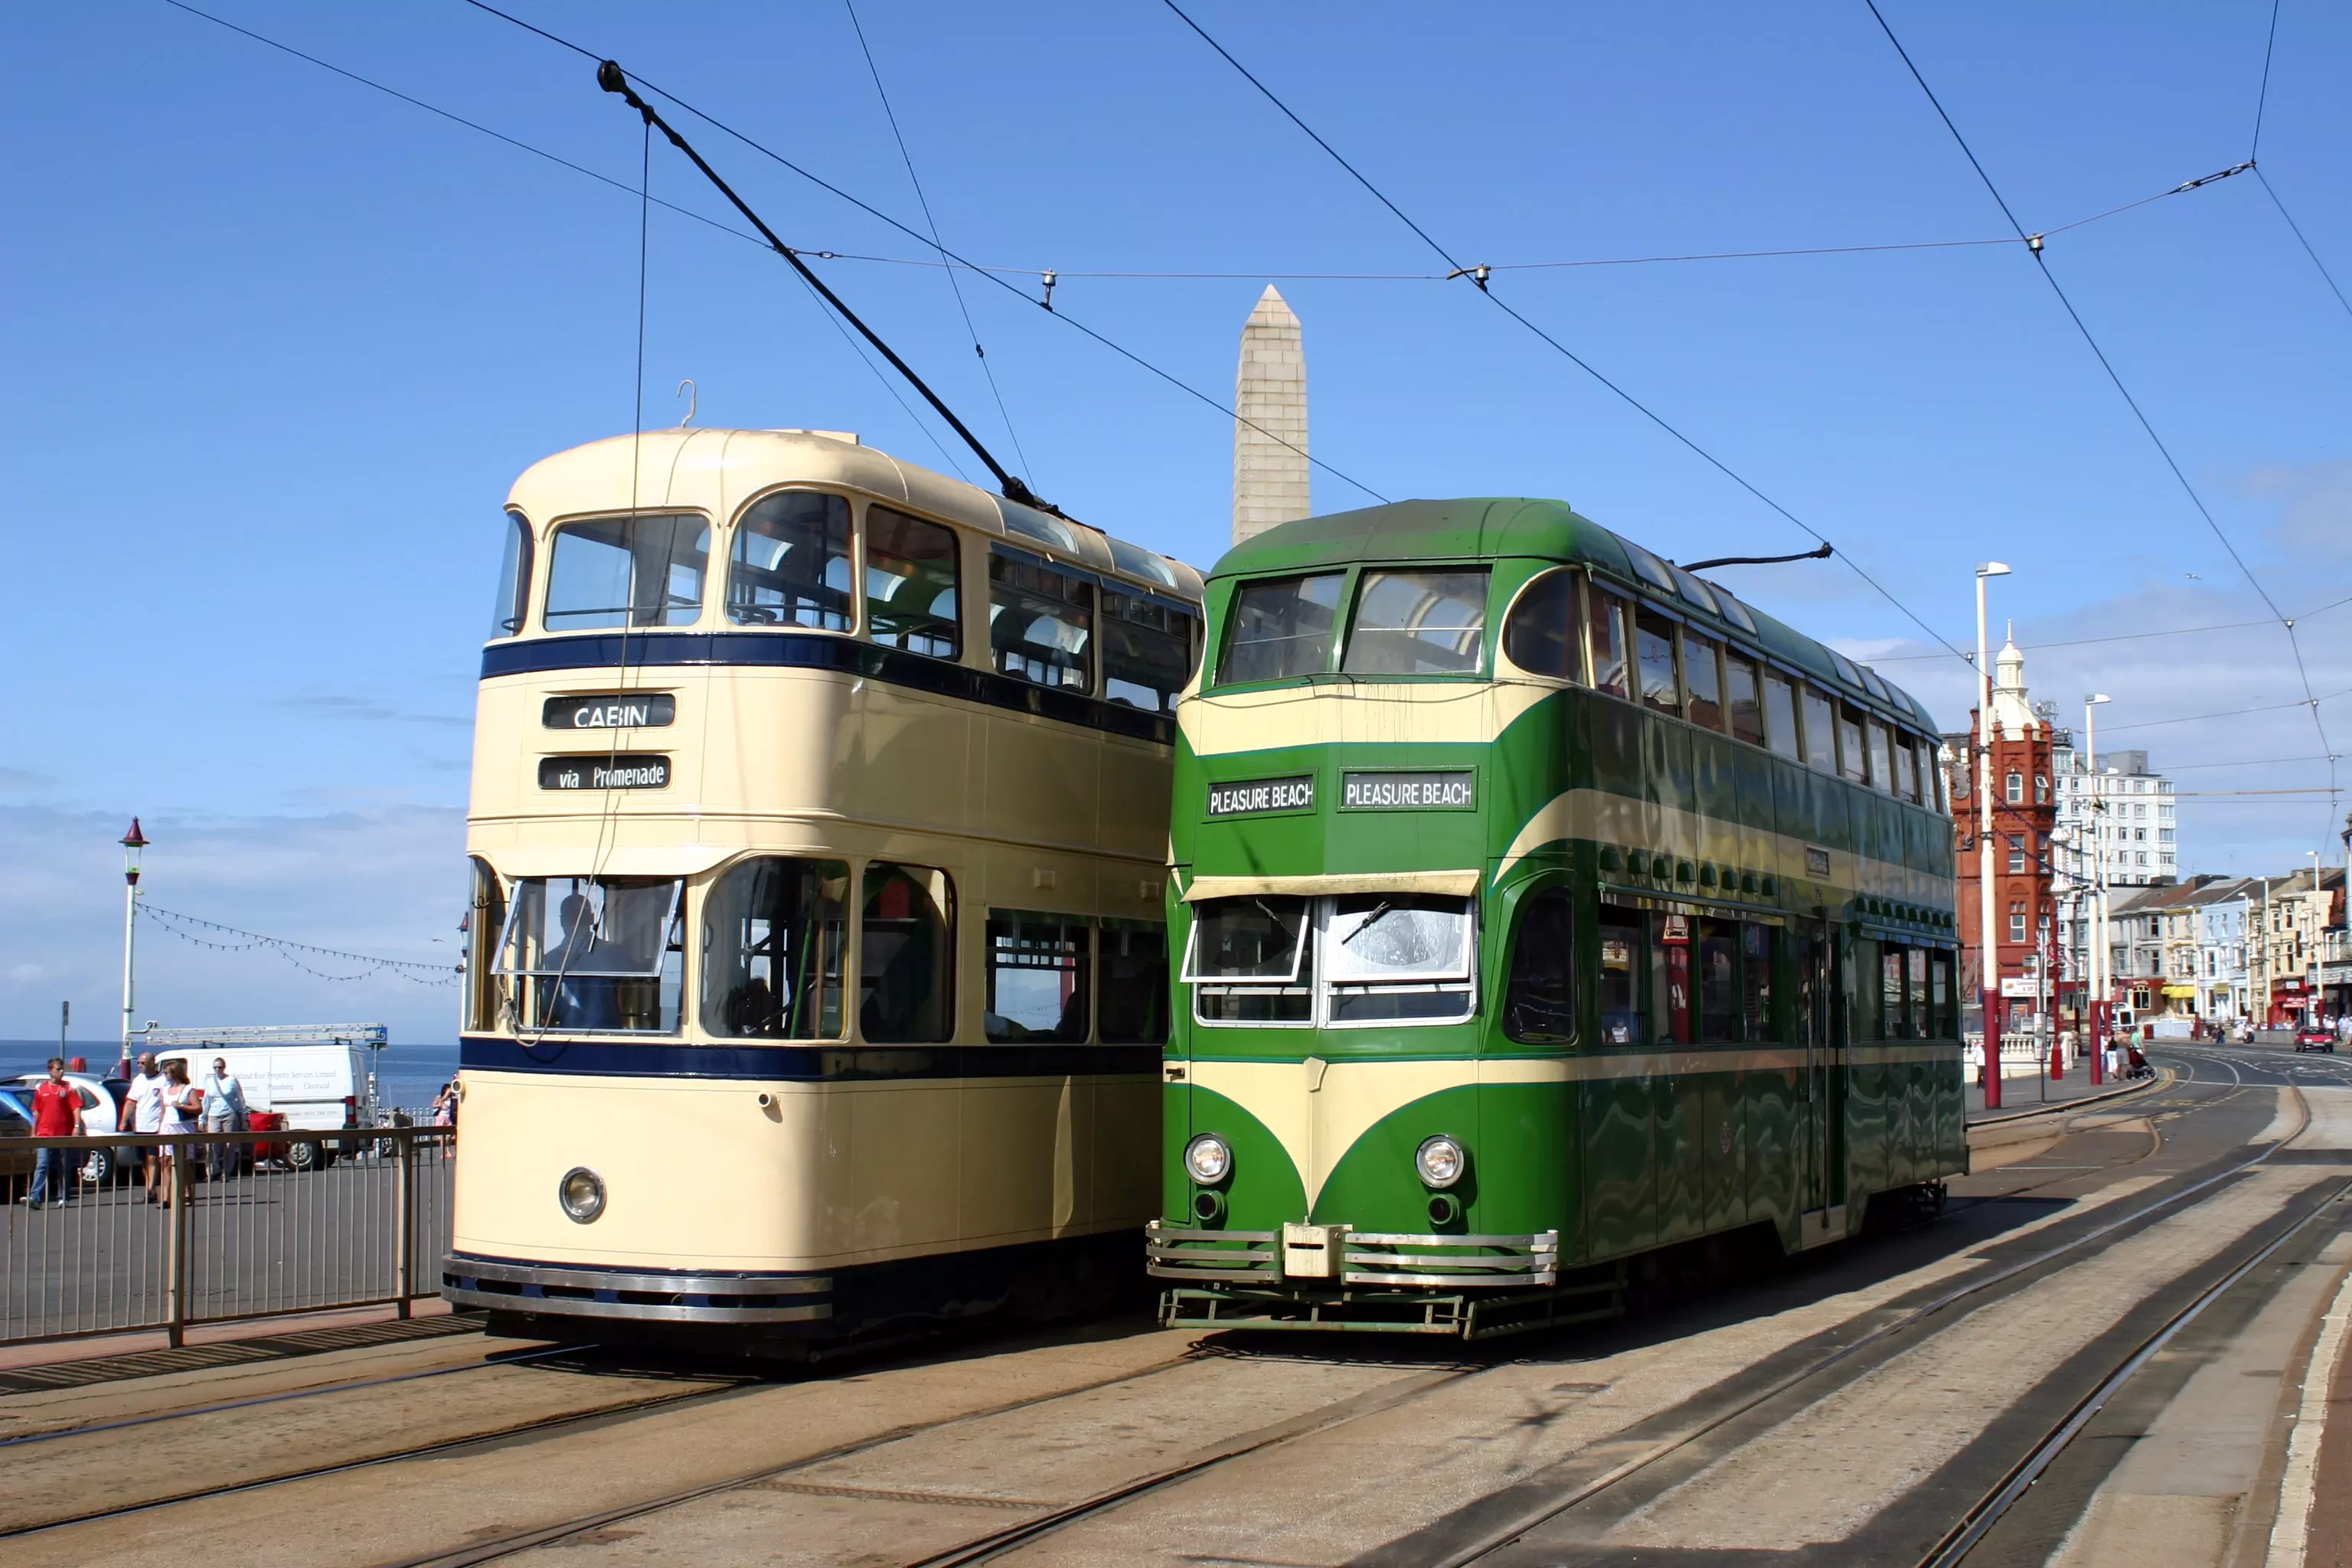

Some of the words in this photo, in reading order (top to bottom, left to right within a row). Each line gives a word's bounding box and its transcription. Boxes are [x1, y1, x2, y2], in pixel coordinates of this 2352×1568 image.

[573, 704, 648, 728] CABIN
[559, 769, 580, 789] via
[593, 762, 665, 789] Promenade
[1210, 786, 1270, 814] PLEASURE
[1272, 783, 1313, 808] BEACH
[1346, 783, 1419, 805] PLEASURE
[1422, 782, 1472, 805] BEACH
[303, 1081, 330, 1089] Electrical
[315, 1070, 337, 1078] Limited
